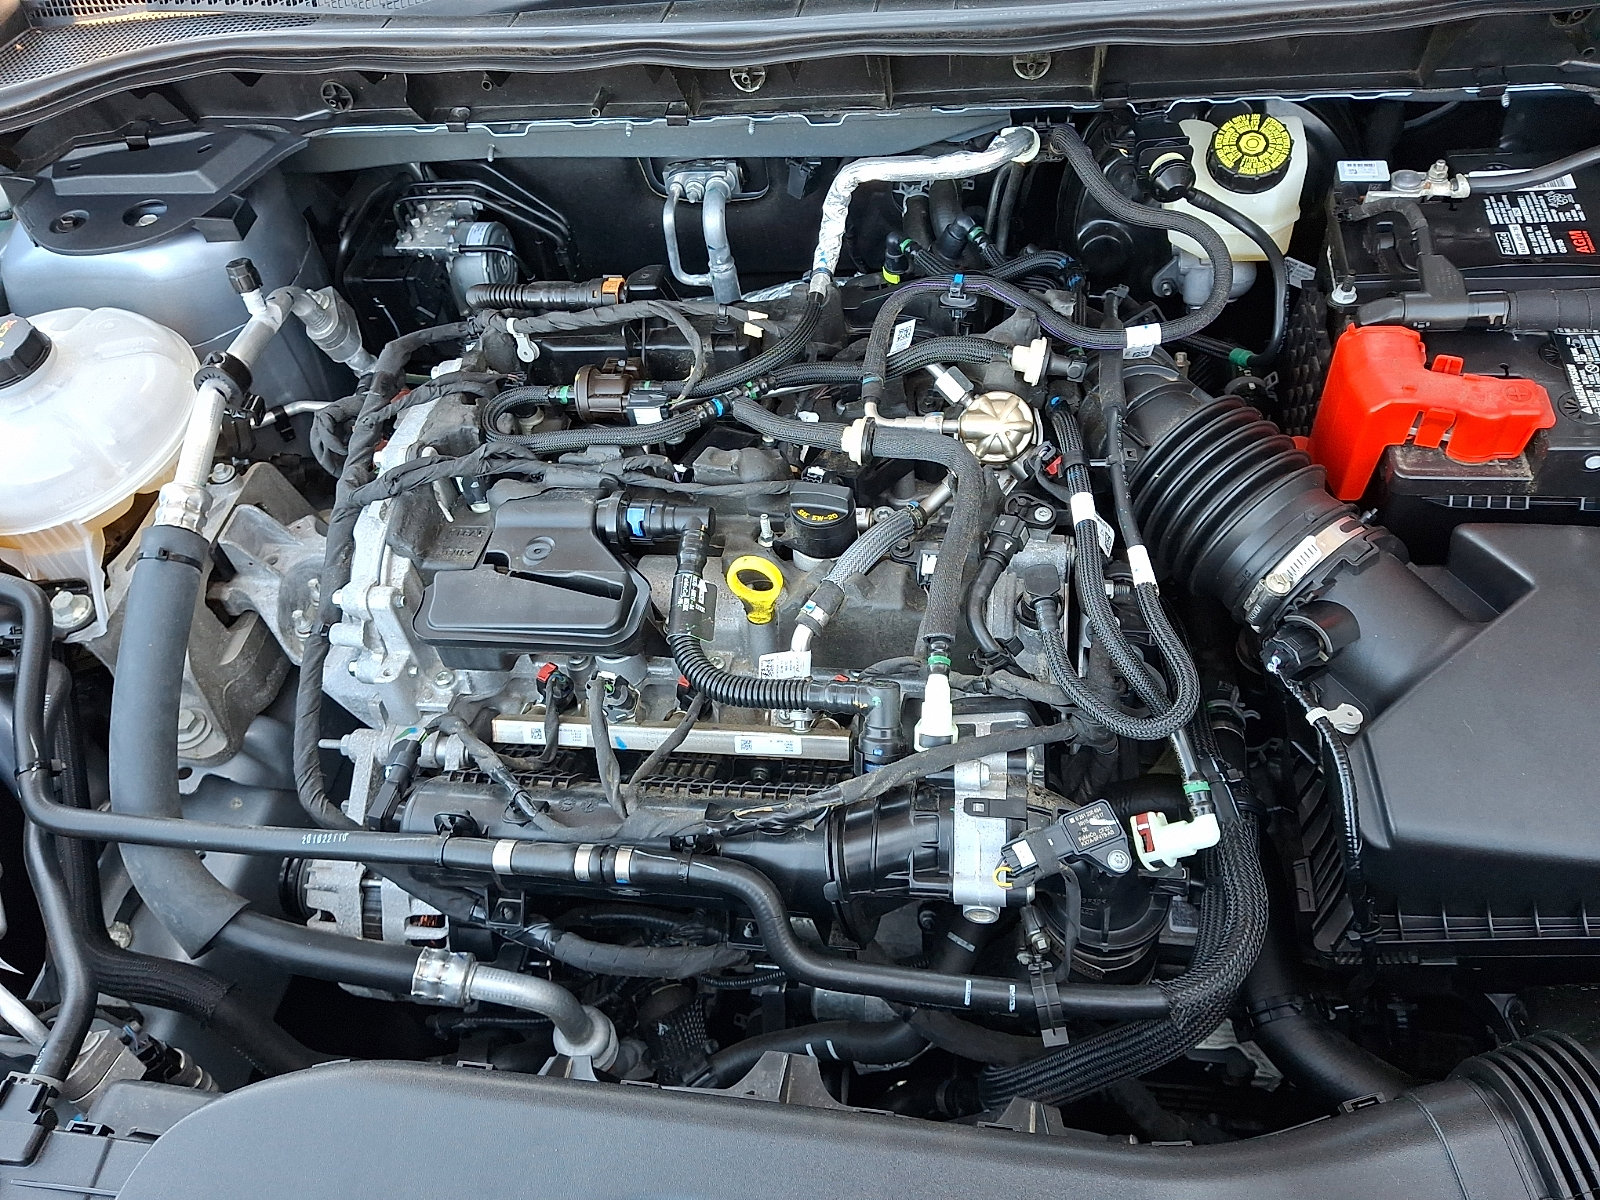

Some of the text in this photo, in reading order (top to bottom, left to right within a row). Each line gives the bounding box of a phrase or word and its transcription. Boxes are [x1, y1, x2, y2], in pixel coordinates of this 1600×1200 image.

[1568, 231, 1590, 253] AGM
[797, 509, 810, 519] SAE
[812, 513, 838, 521] 5W-20
